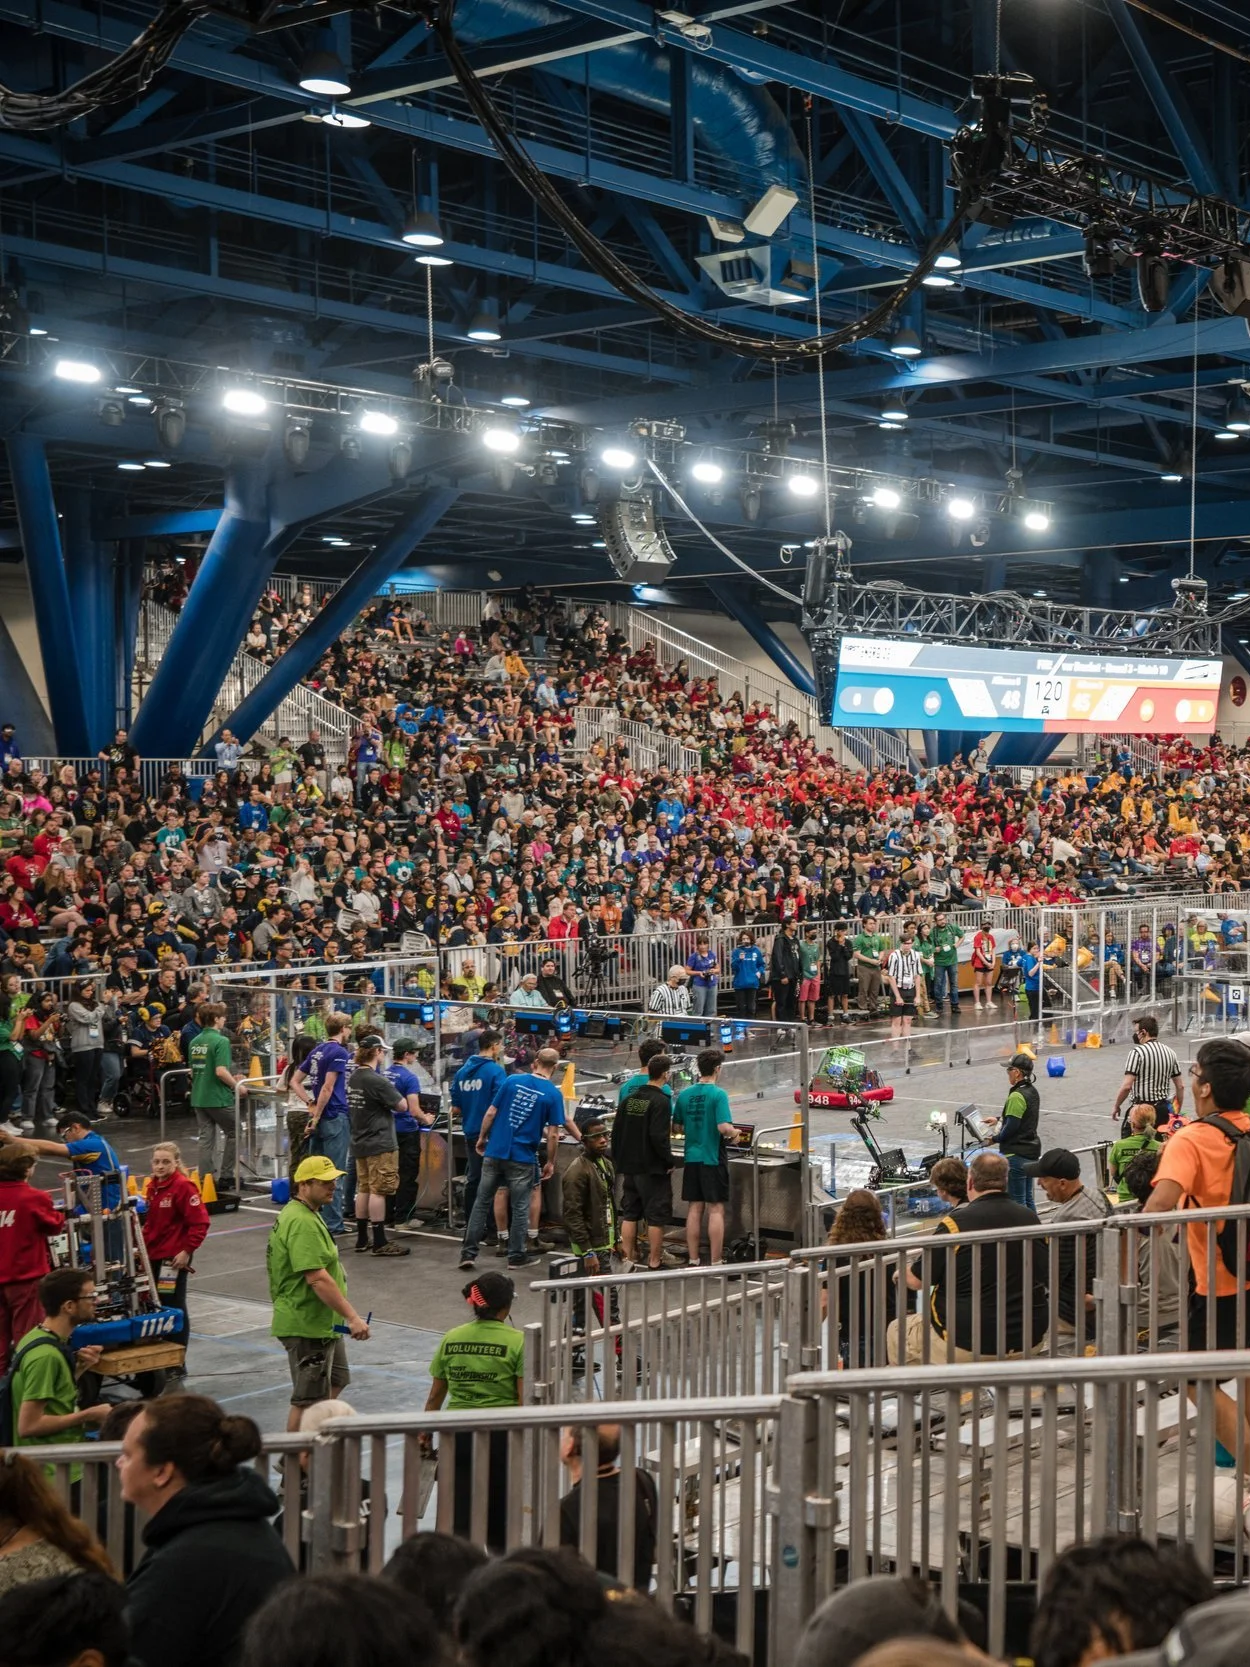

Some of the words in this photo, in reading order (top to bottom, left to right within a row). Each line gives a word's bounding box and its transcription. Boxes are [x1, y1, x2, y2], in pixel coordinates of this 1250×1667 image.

[1035, 681, 1063, 701] 120
[808, 1094, 829, 1105] 948
[0, 1210, 16, 1228] 14
[140, 1315, 175, 1337] 1114
[448, 1345, 502, 1355] VOLUNTEER
